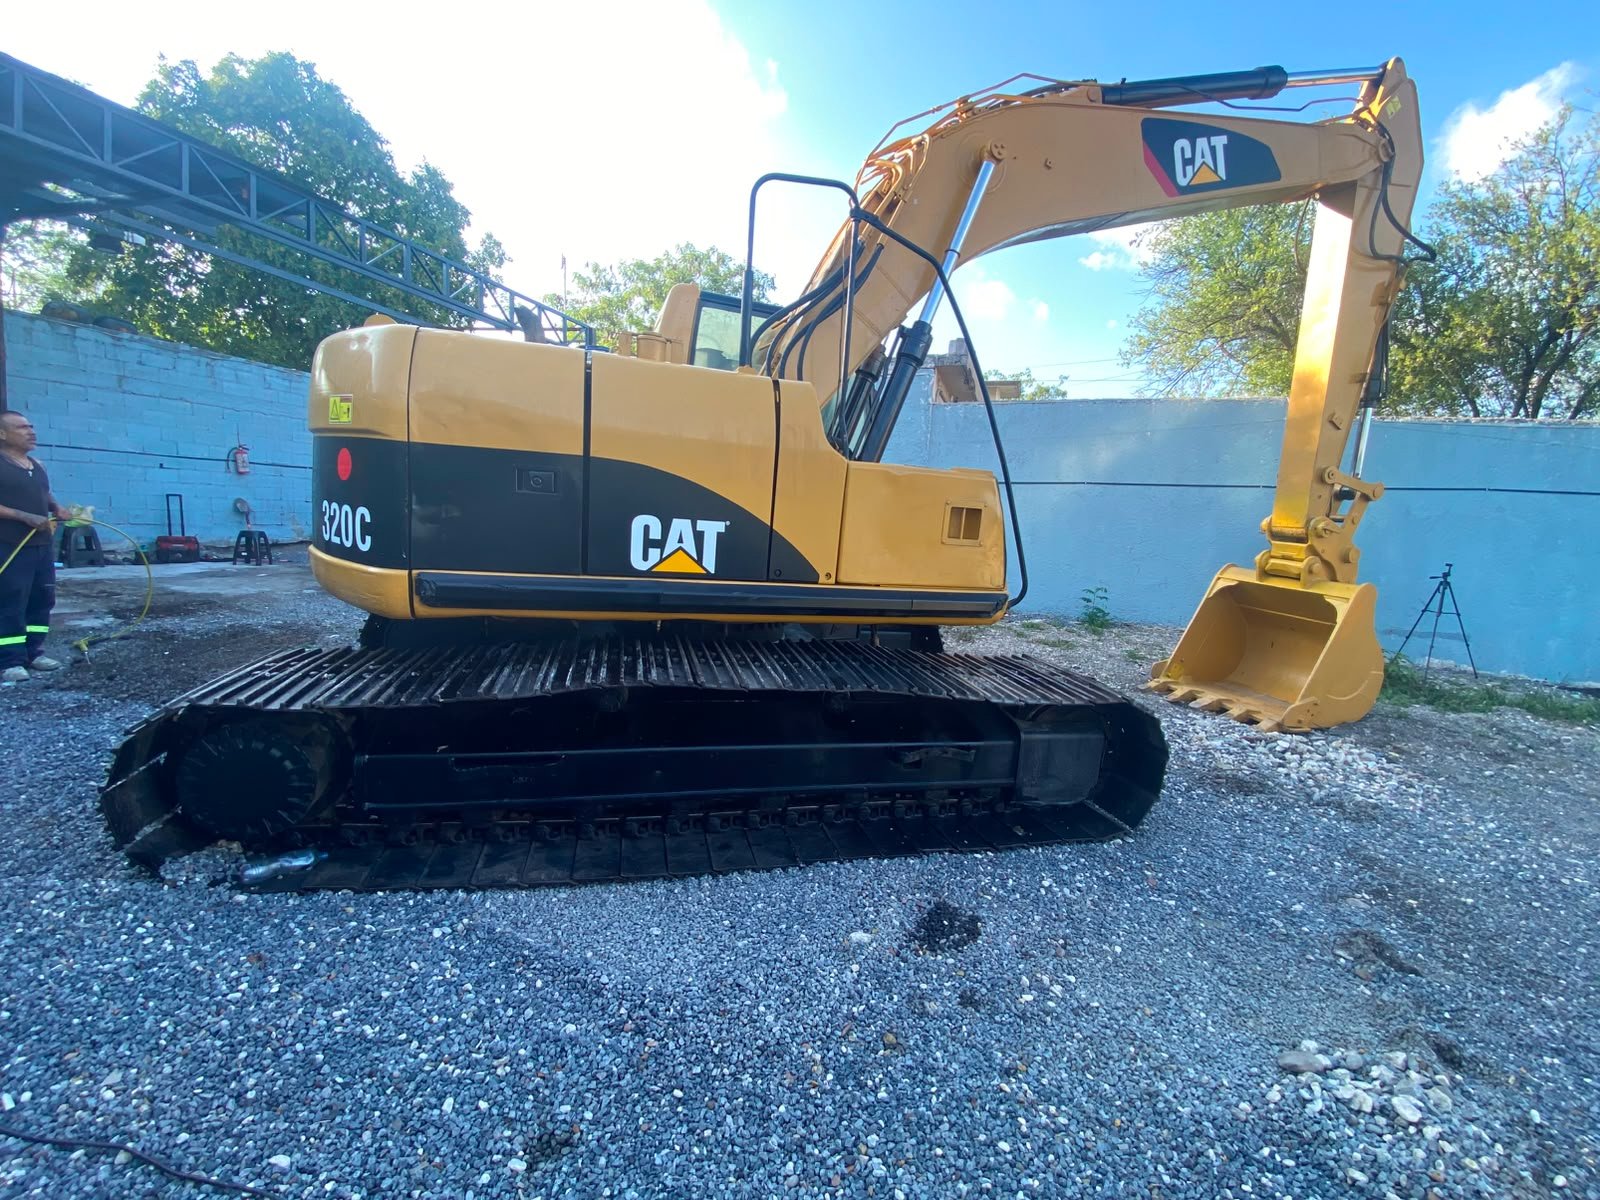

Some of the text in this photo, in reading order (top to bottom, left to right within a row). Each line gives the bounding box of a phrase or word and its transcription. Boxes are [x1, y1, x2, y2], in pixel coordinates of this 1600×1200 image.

[1173, 135, 1228, 187] CAT
[322, 500, 371, 552] 320C
[630, 514, 726, 574] CAT
